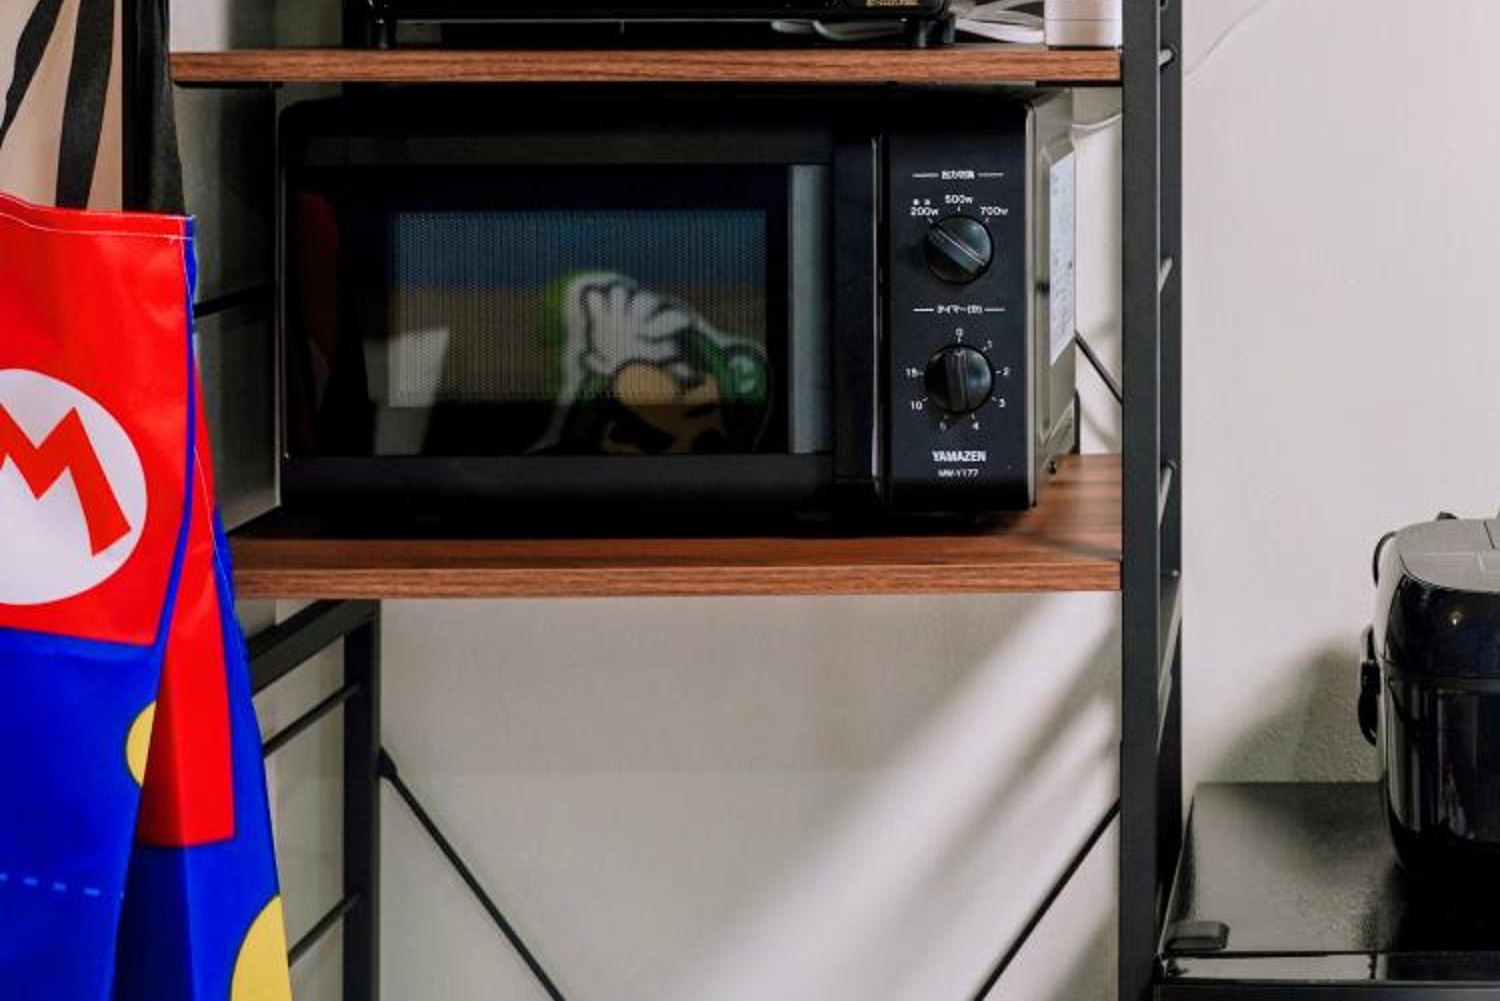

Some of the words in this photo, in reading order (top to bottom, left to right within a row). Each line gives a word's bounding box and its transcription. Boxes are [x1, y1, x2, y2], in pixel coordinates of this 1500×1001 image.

[911, 401, 923, 411] 10
[932, 450, 987, 462] YAMAZEN
[0, 402, 132, 556] M
